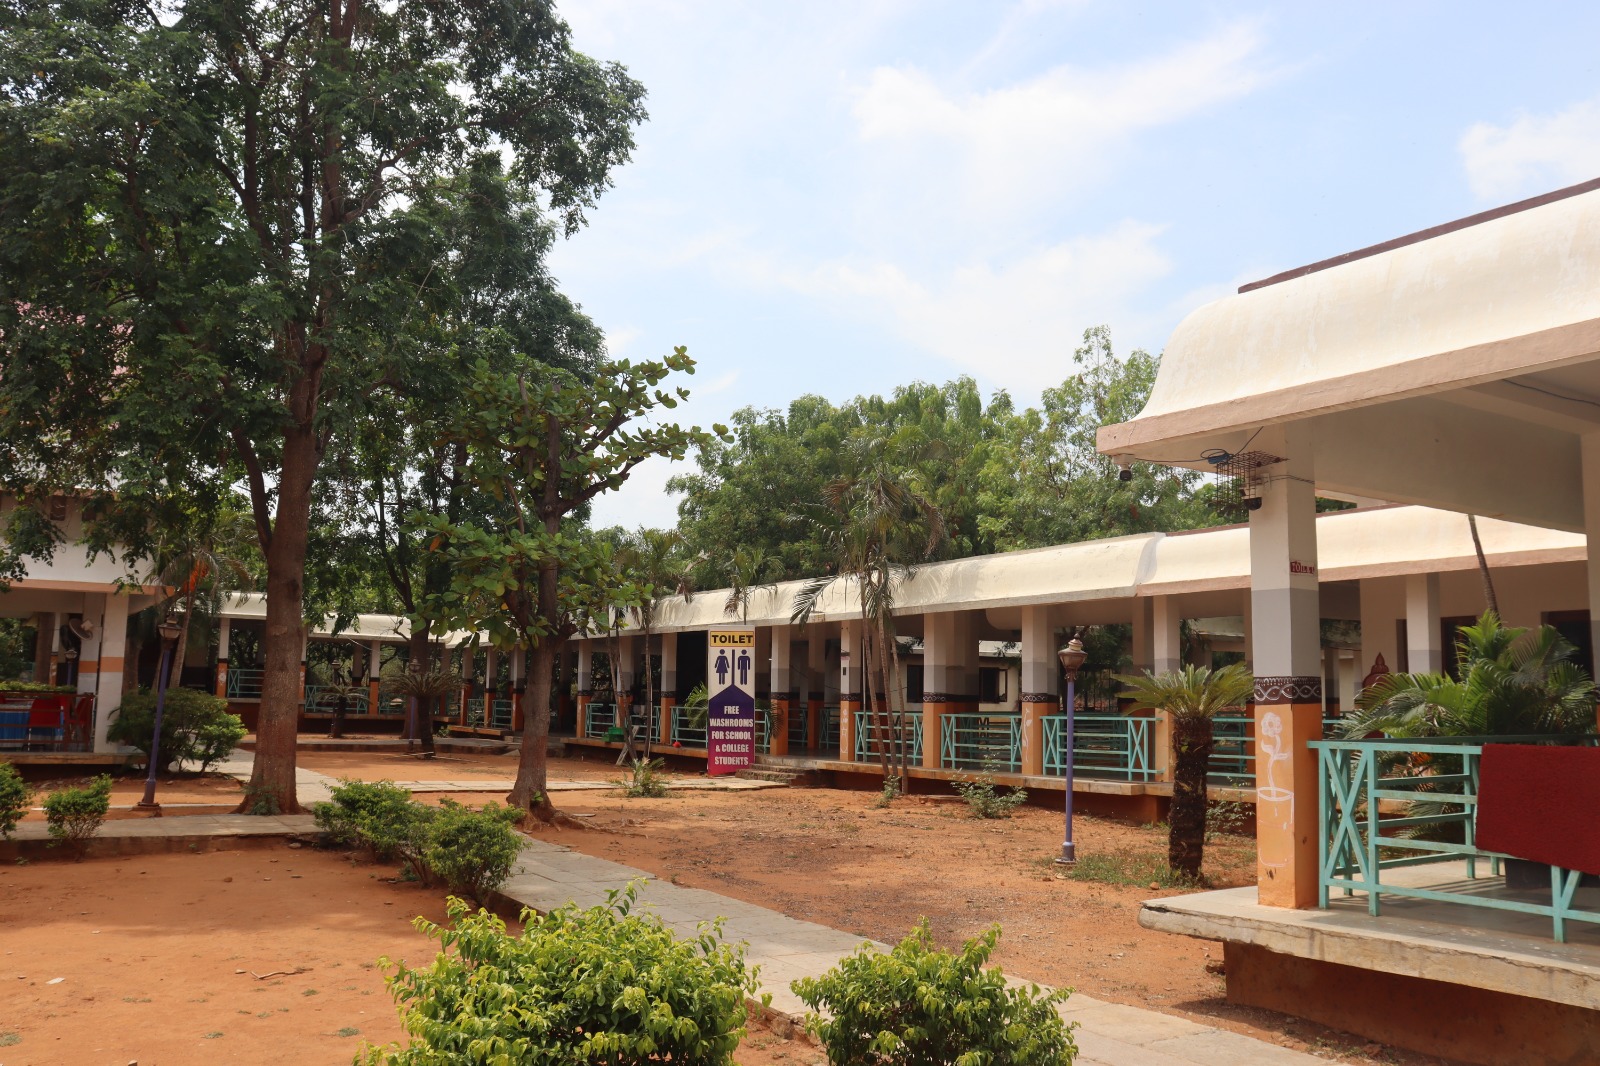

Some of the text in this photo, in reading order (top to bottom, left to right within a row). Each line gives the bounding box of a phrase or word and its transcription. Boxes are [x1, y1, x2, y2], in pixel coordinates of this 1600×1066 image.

[711, 635, 754, 643] TOILET
[724, 706, 740, 715] FREE
[709, 718, 754, 727] WASHROOMS
[711, 731, 752, 740] FOR SCHOOL
[721, 744, 749, 752] COLLEGE
[714, 756, 749, 766] STUDENTS
